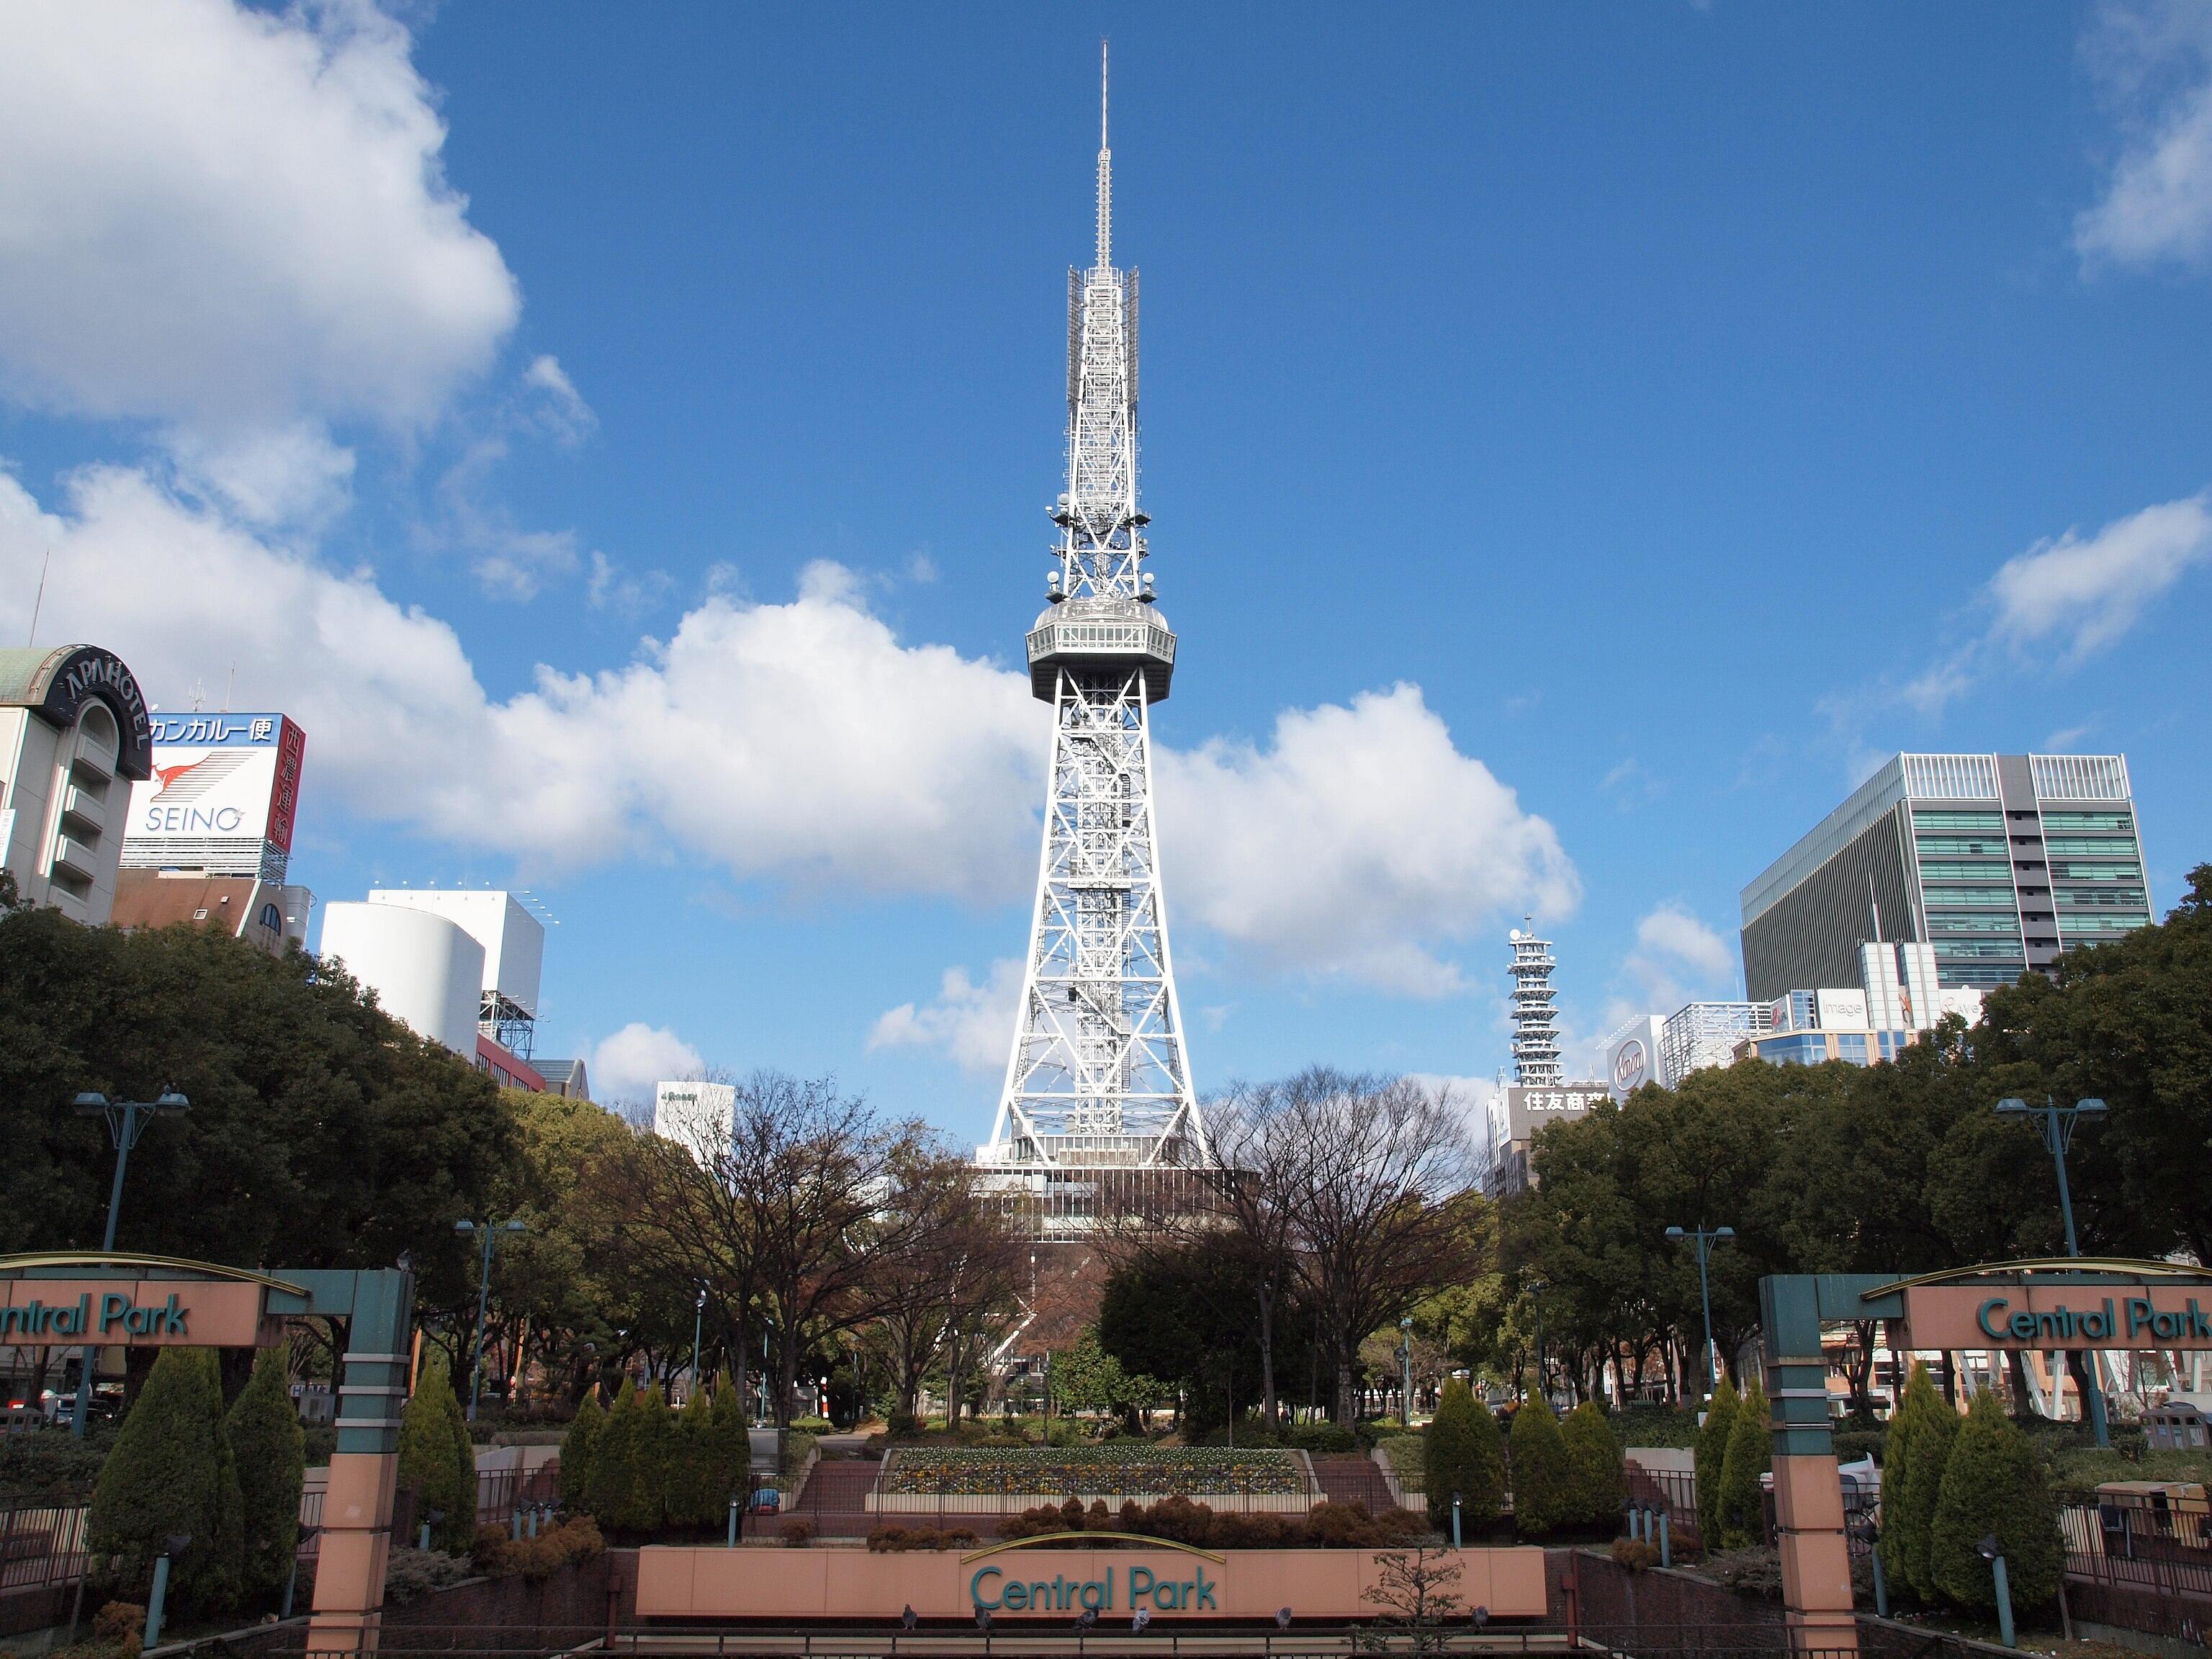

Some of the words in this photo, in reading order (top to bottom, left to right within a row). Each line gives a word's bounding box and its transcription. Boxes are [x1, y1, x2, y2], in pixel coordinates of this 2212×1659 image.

[66, 658, 105, 700] APA
[106, 662, 149, 750] HOTEL
[149, 719, 273, 742] カンガルー便
[274, 723, 305, 845] 西濃運輸
[145, 806, 241, 832] SEINO
[1823, 999, 1862, 1017] Image
[99, 1292, 190, 1335] Park
[1977, 1297, 2117, 1339] Central
[2123, 1297, 2212, 1338] Park
[971, 1566, 1113, 1609] Central
[1129, 1566, 1217, 1609] Park
